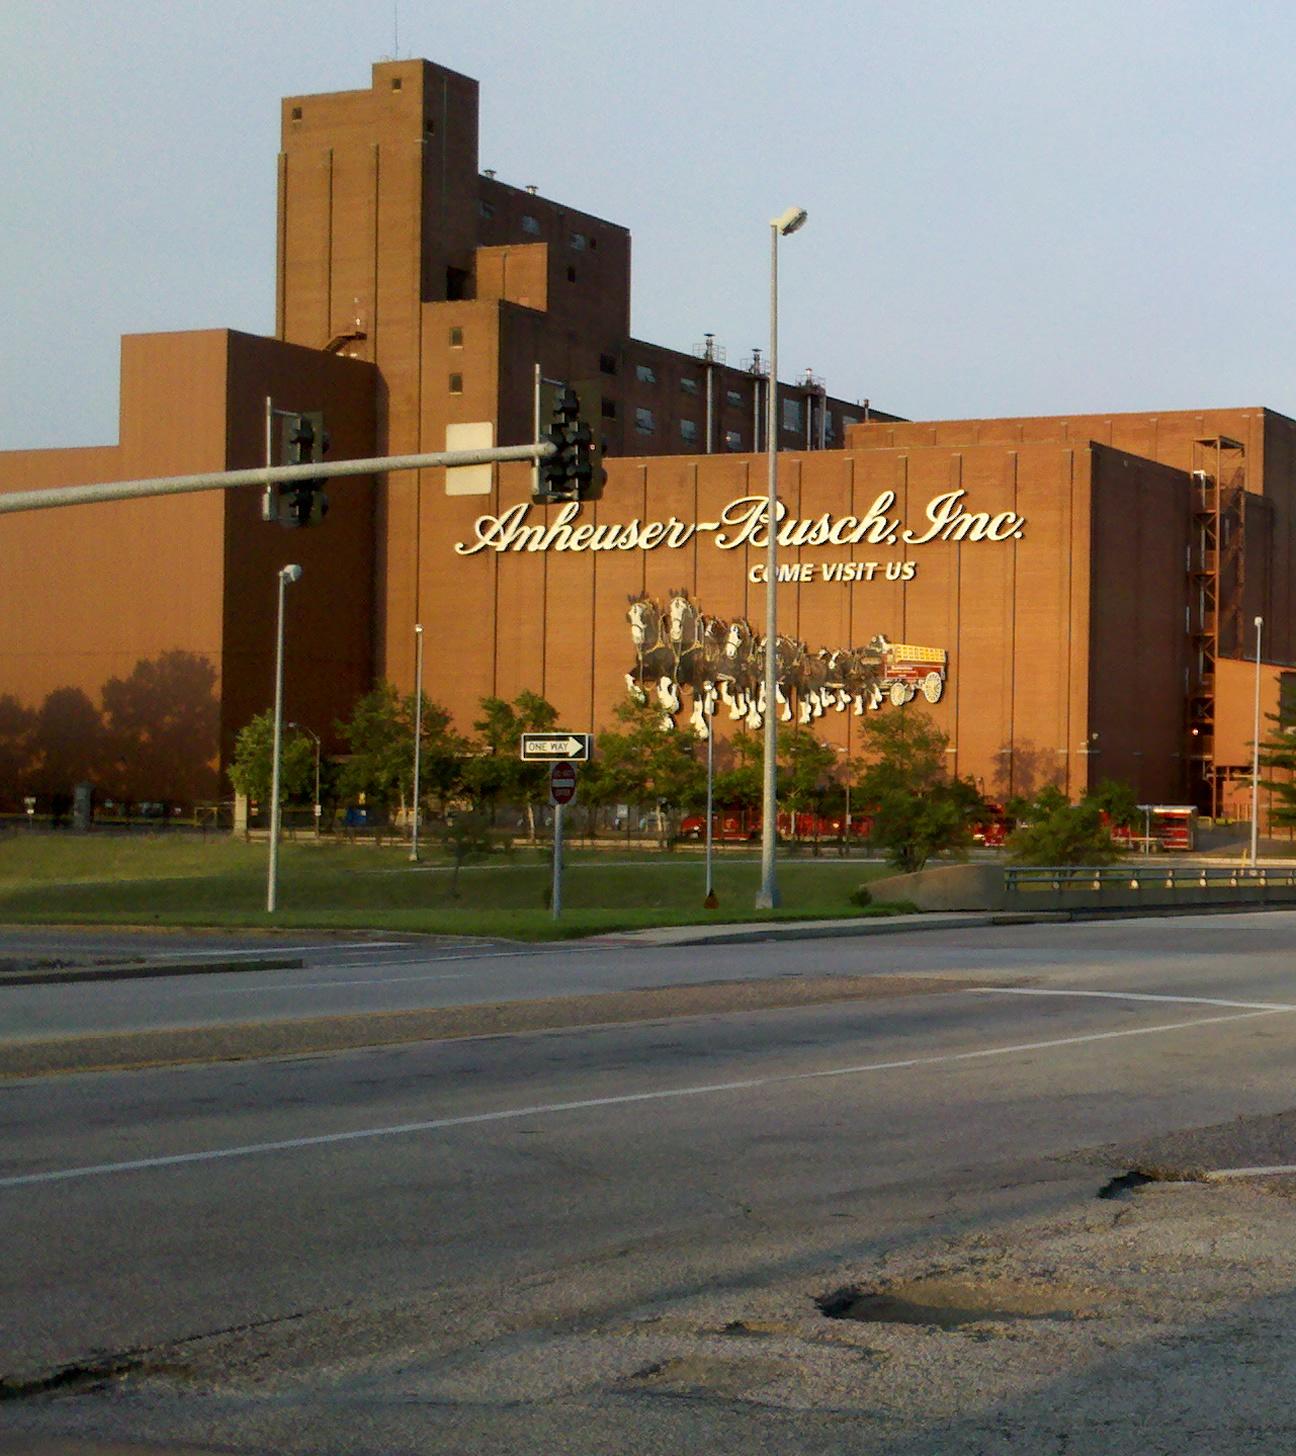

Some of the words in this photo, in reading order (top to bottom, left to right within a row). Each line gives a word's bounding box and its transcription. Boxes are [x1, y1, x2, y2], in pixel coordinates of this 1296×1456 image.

[902, 488, 1025, 545] Inc.
[821, 562, 878, 582] VISIT
[885, 561, 916, 581] US
[528, 742, 548, 752] ONE
[550, 742, 569, 752] WAY
